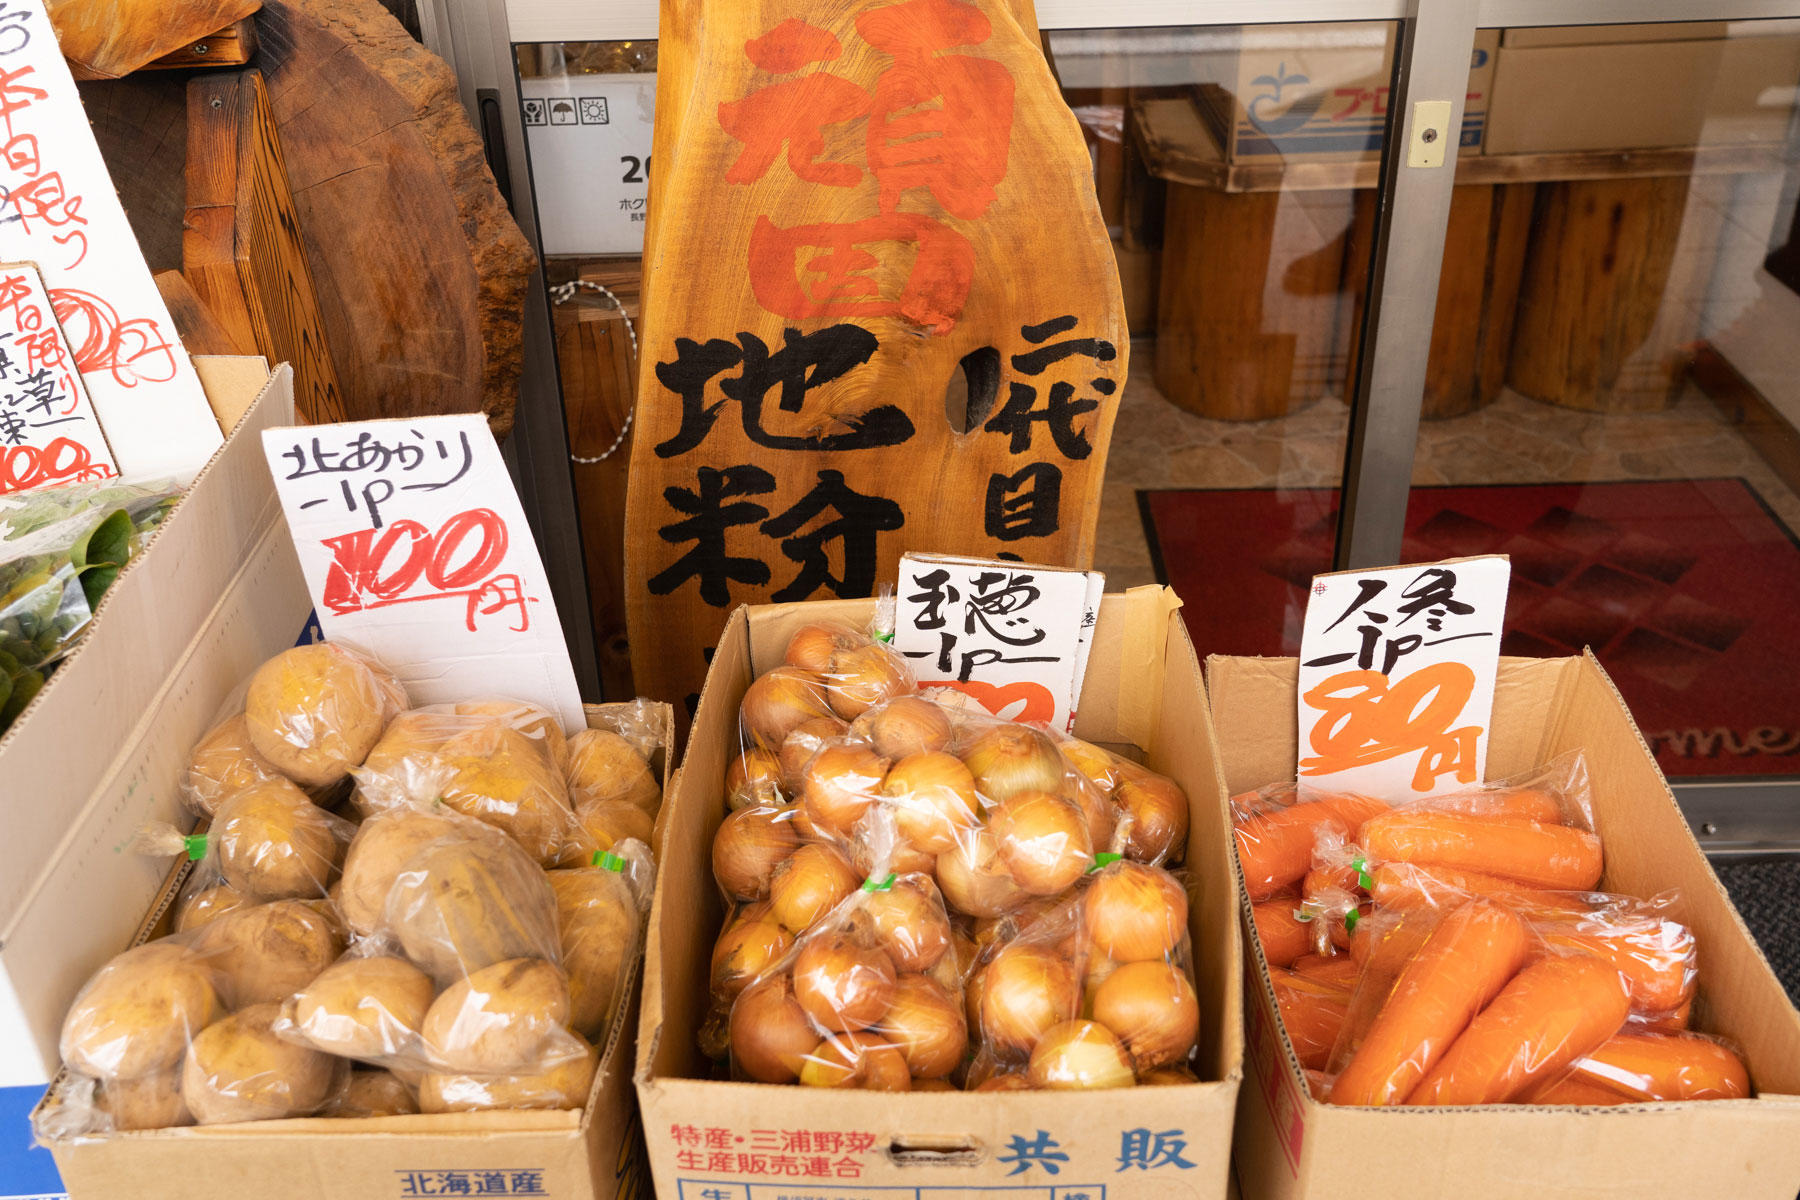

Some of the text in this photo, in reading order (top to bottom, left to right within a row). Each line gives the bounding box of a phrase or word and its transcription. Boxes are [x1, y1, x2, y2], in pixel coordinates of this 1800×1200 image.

[619, 198, 647, 210] ホク
[985, 314, 1117, 561] 二代目
[282, 429, 474, 490] 北あかり
[677, 1150, 865, 1179] 生産販売連合
[401, 1170, 545, 1196] 北海道産
